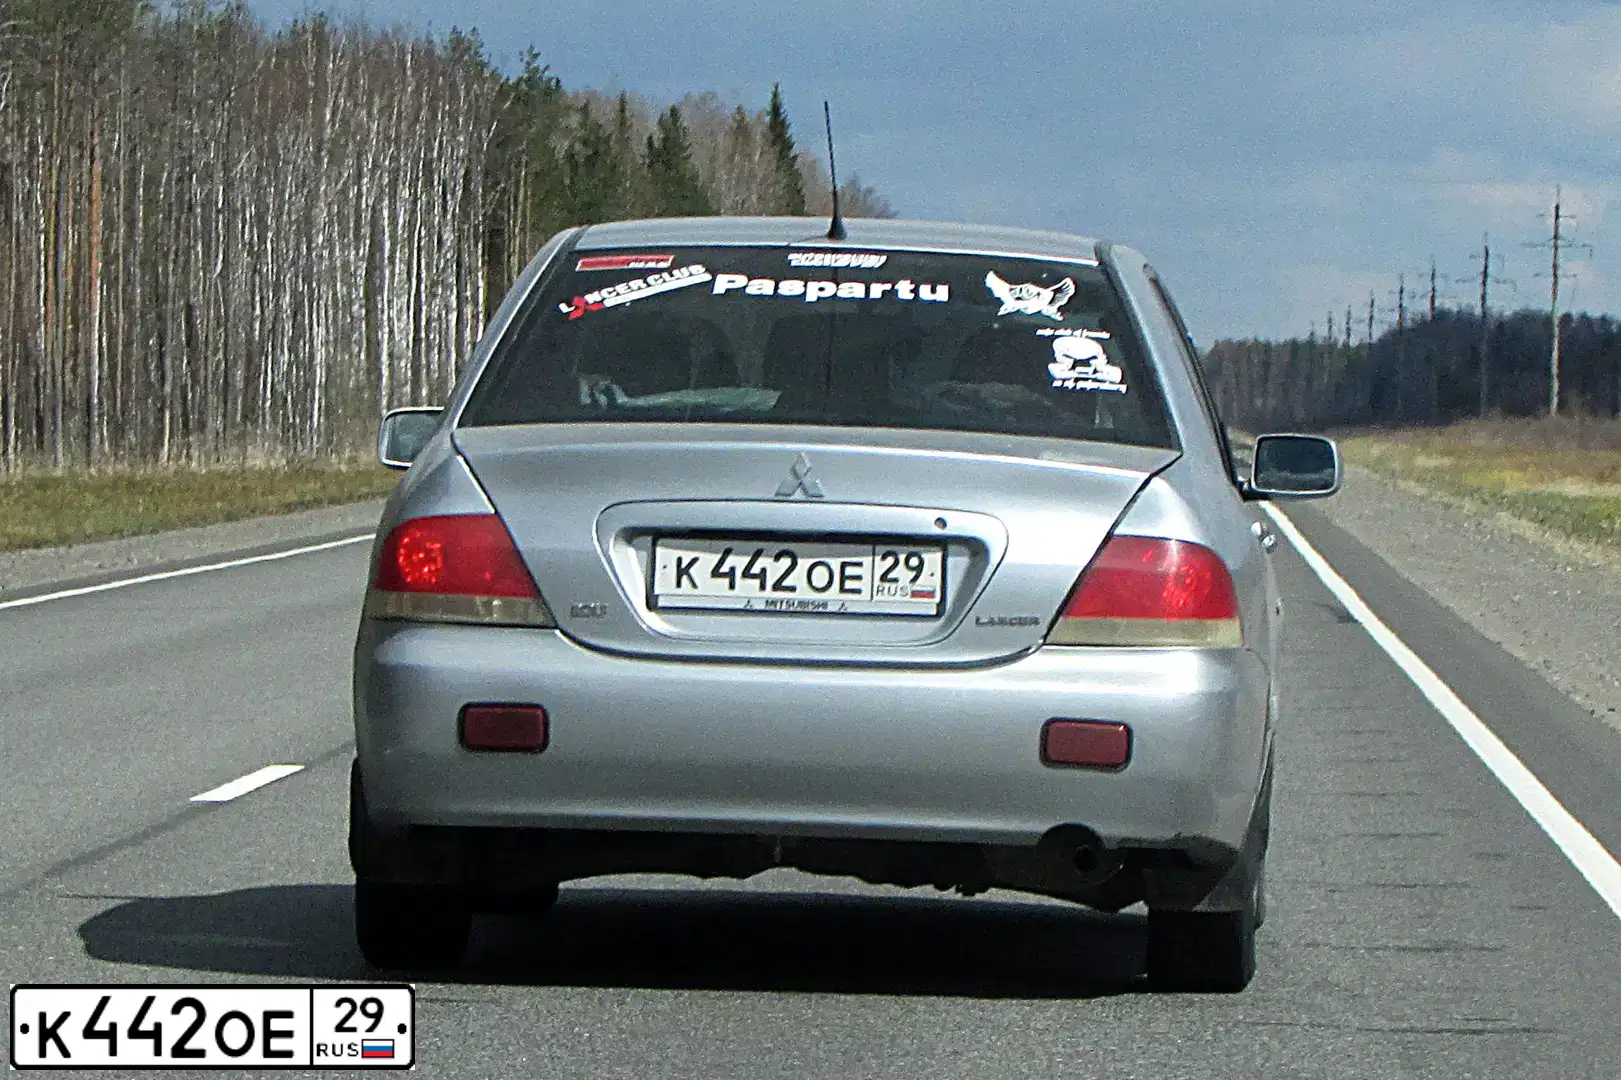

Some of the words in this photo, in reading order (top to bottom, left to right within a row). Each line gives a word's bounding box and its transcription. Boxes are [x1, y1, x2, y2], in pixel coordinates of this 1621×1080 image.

[712, 273, 949, 302] Paspartu
[879, 550, 925, 583] 29
[876, 585, 909, 597] RUS
